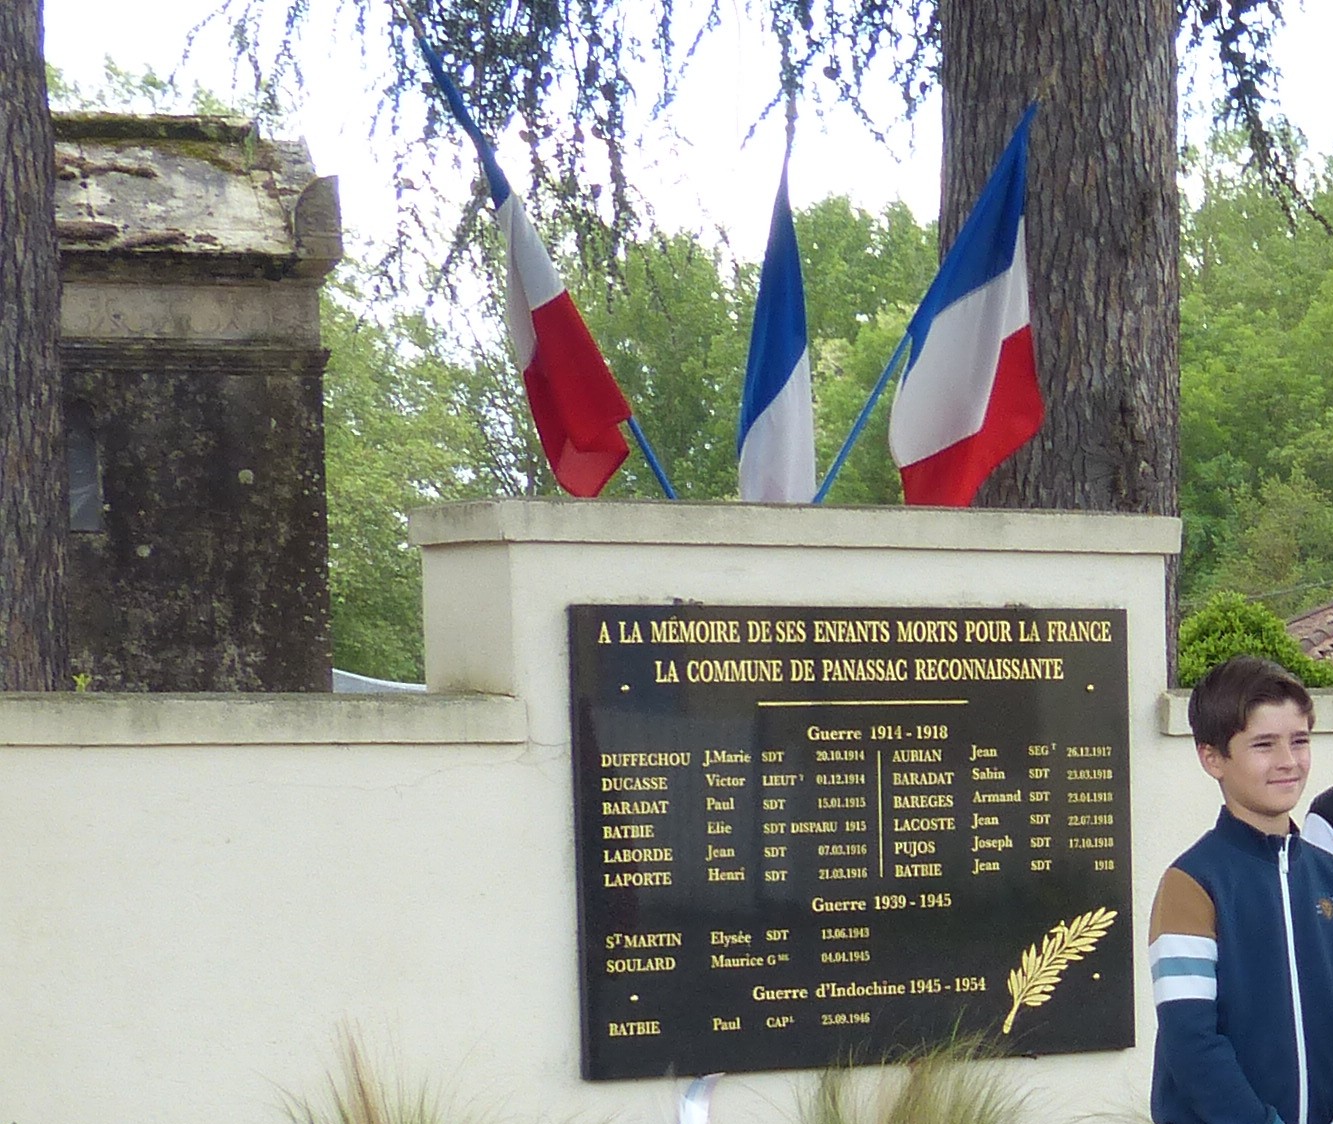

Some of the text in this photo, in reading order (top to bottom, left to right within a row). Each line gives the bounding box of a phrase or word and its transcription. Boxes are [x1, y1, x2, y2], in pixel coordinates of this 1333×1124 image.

[598, 622, 611, 643] A
[619, 621, 643, 643] LA
[747, 621, 772, 642] DE
[776, 621, 806, 642] SES
[814, 621, 890, 642] ENFANTS
[897, 621, 958, 642] MORTS
[965, 621, 1012, 642] POUR
[1019, 621, 1040, 642] LA
[1047, 621, 1111, 642] FRANCE
[655, 658, 1064, 682] LA COMMUNE DE PANASSAC RECONNAISSANTE
[807, 726, 862, 740] Guerre
[871, 726, 902, 739] 1914
[917, 725, 948, 739] 1918
[601, 753, 690, 767] DUFFECHOU
[762, 752, 784, 762] SDT
[893, 749, 941, 762] AUBIAN
[969, 745, 997, 761] Jean
[602, 777, 668, 791] DUCASSE
[706, 774, 745, 786] Victor
[816, 774, 865, 784] 01.12.1914
[893, 772, 954, 785] BARADAT
[972, 768, 1005, 780] Sabin
[1029, 768, 1050, 778] SDT
[603, 801, 669, 815] BARADAT
[706, 798, 734, 810] Paul
[763, 799, 786, 810] SDT
[894, 795, 953, 808] BAREGES
[973, 790, 1021, 803] Armand
[1030, 792, 1050, 801] SDT
[603, 821, 866, 839] BATBIE Elie SDT DISPARU 1915
[894, 818, 955, 831] LACOSTE
[971, 813, 999, 829] Jean
[1030, 814, 1051, 824] SDT
[604, 848, 673, 863] LABORDE
[705, 845, 735, 861] Jean
[764, 847, 787, 857] SDT
[895, 841, 935, 857] PUJOS
[972, 835, 1013, 852] Joseph
[1031, 837, 1051, 848] SDT
[604, 872, 672, 887] LAPORTE
[708, 867, 745, 881] Henri
[765, 871, 787, 881] SDT
[895, 859, 1114, 877] BATBIE Jean SDT 1918
[812, 898, 866, 912] Guerre
[875, 895, 906, 909] 1939
[920, 893, 951, 907] 1945
[624, 933, 681, 948] MARTIN
[766, 930, 789, 940] SDT
[607, 957, 675, 972] SOULARD
[711, 953, 763, 968] Maurice
[753, 986, 808, 1000] Guerre
[910, 979, 941, 993] 1945
[955, 977, 986, 992] 1954
[609, 1021, 660, 1036] BATBIE
[713, 1017, 741, 1030] Paul
